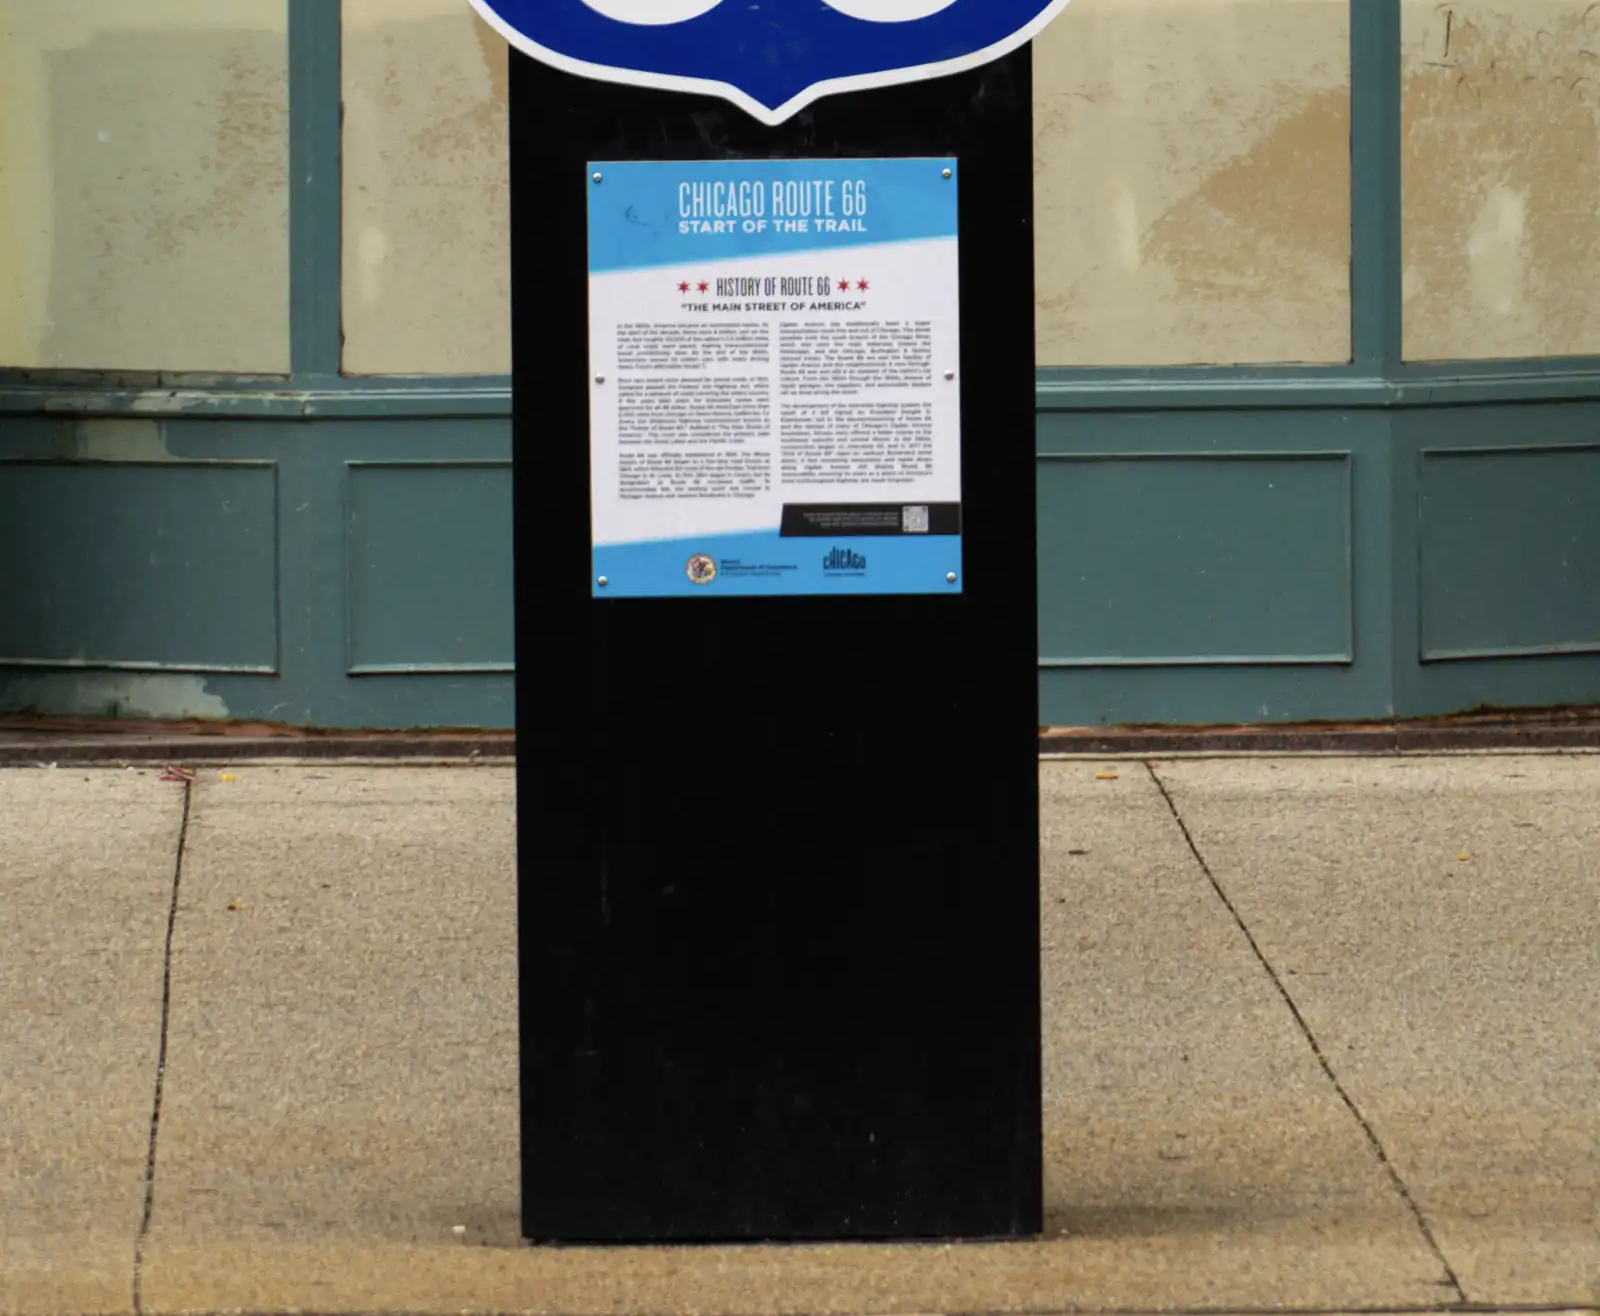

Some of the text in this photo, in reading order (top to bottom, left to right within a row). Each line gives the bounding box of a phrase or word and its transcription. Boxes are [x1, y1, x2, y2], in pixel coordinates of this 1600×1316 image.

[678, 179, 867, 218] CHICAGO ROUTE 66
[678, 219, 867, 234] START OF THE TRAIL
[716, 276, 831, 297] HISTORY OF ROUTE 66
[712, 302, 742, 311] MAIN
[745, 301, 787, 311] STREET
[790, 301, 806, 310] OF
